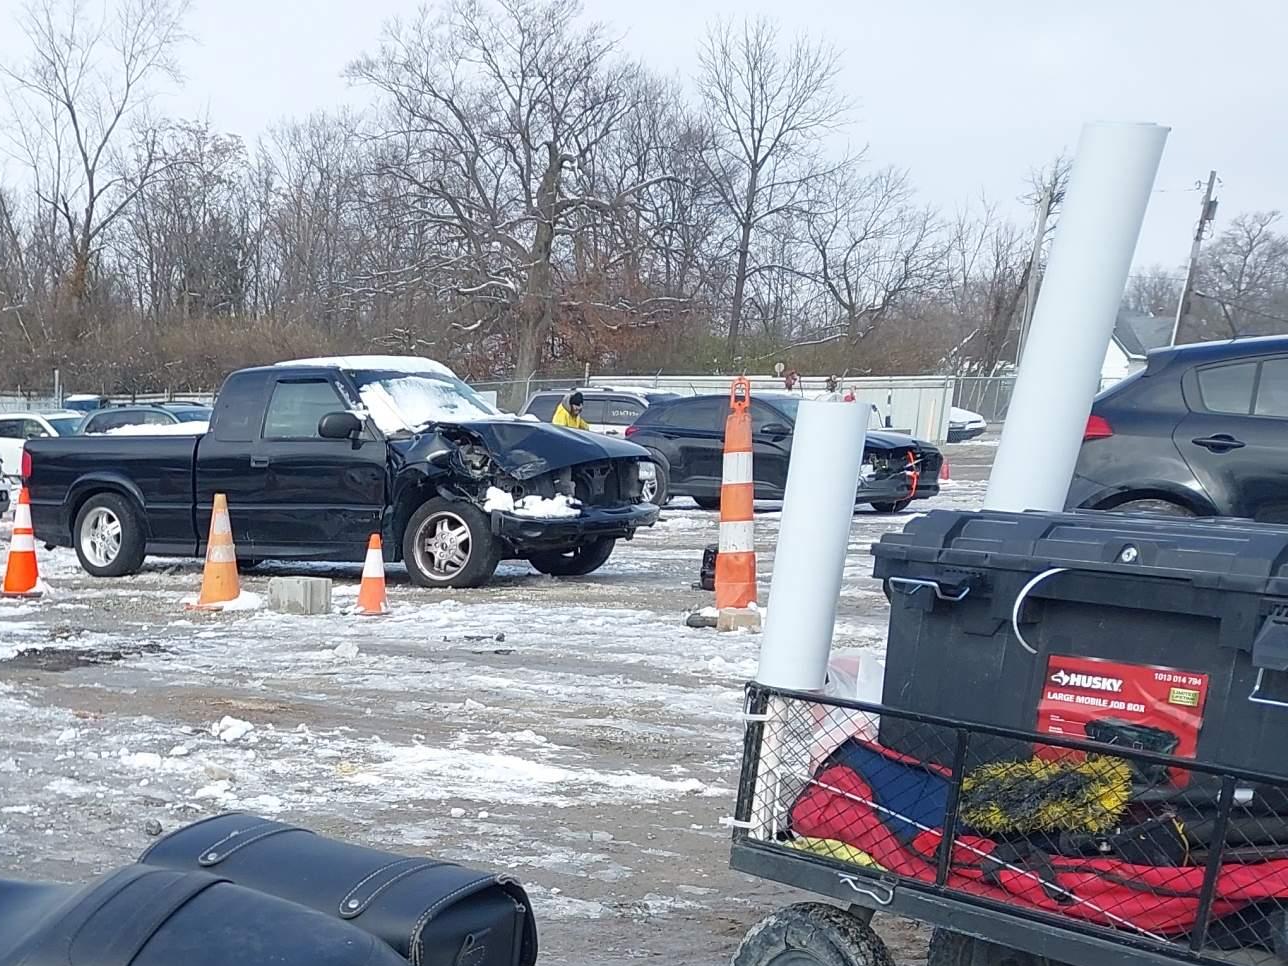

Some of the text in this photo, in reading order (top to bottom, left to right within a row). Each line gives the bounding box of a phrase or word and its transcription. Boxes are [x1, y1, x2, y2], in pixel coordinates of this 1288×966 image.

[1069, 673, 1123, 692] HUSKY
[1154, 673, 1172, 682] 1013
[1173, 675, 1187, 684] 014
[1047, 691, 1146, 713] LARGE MOBILE JOB BOX
